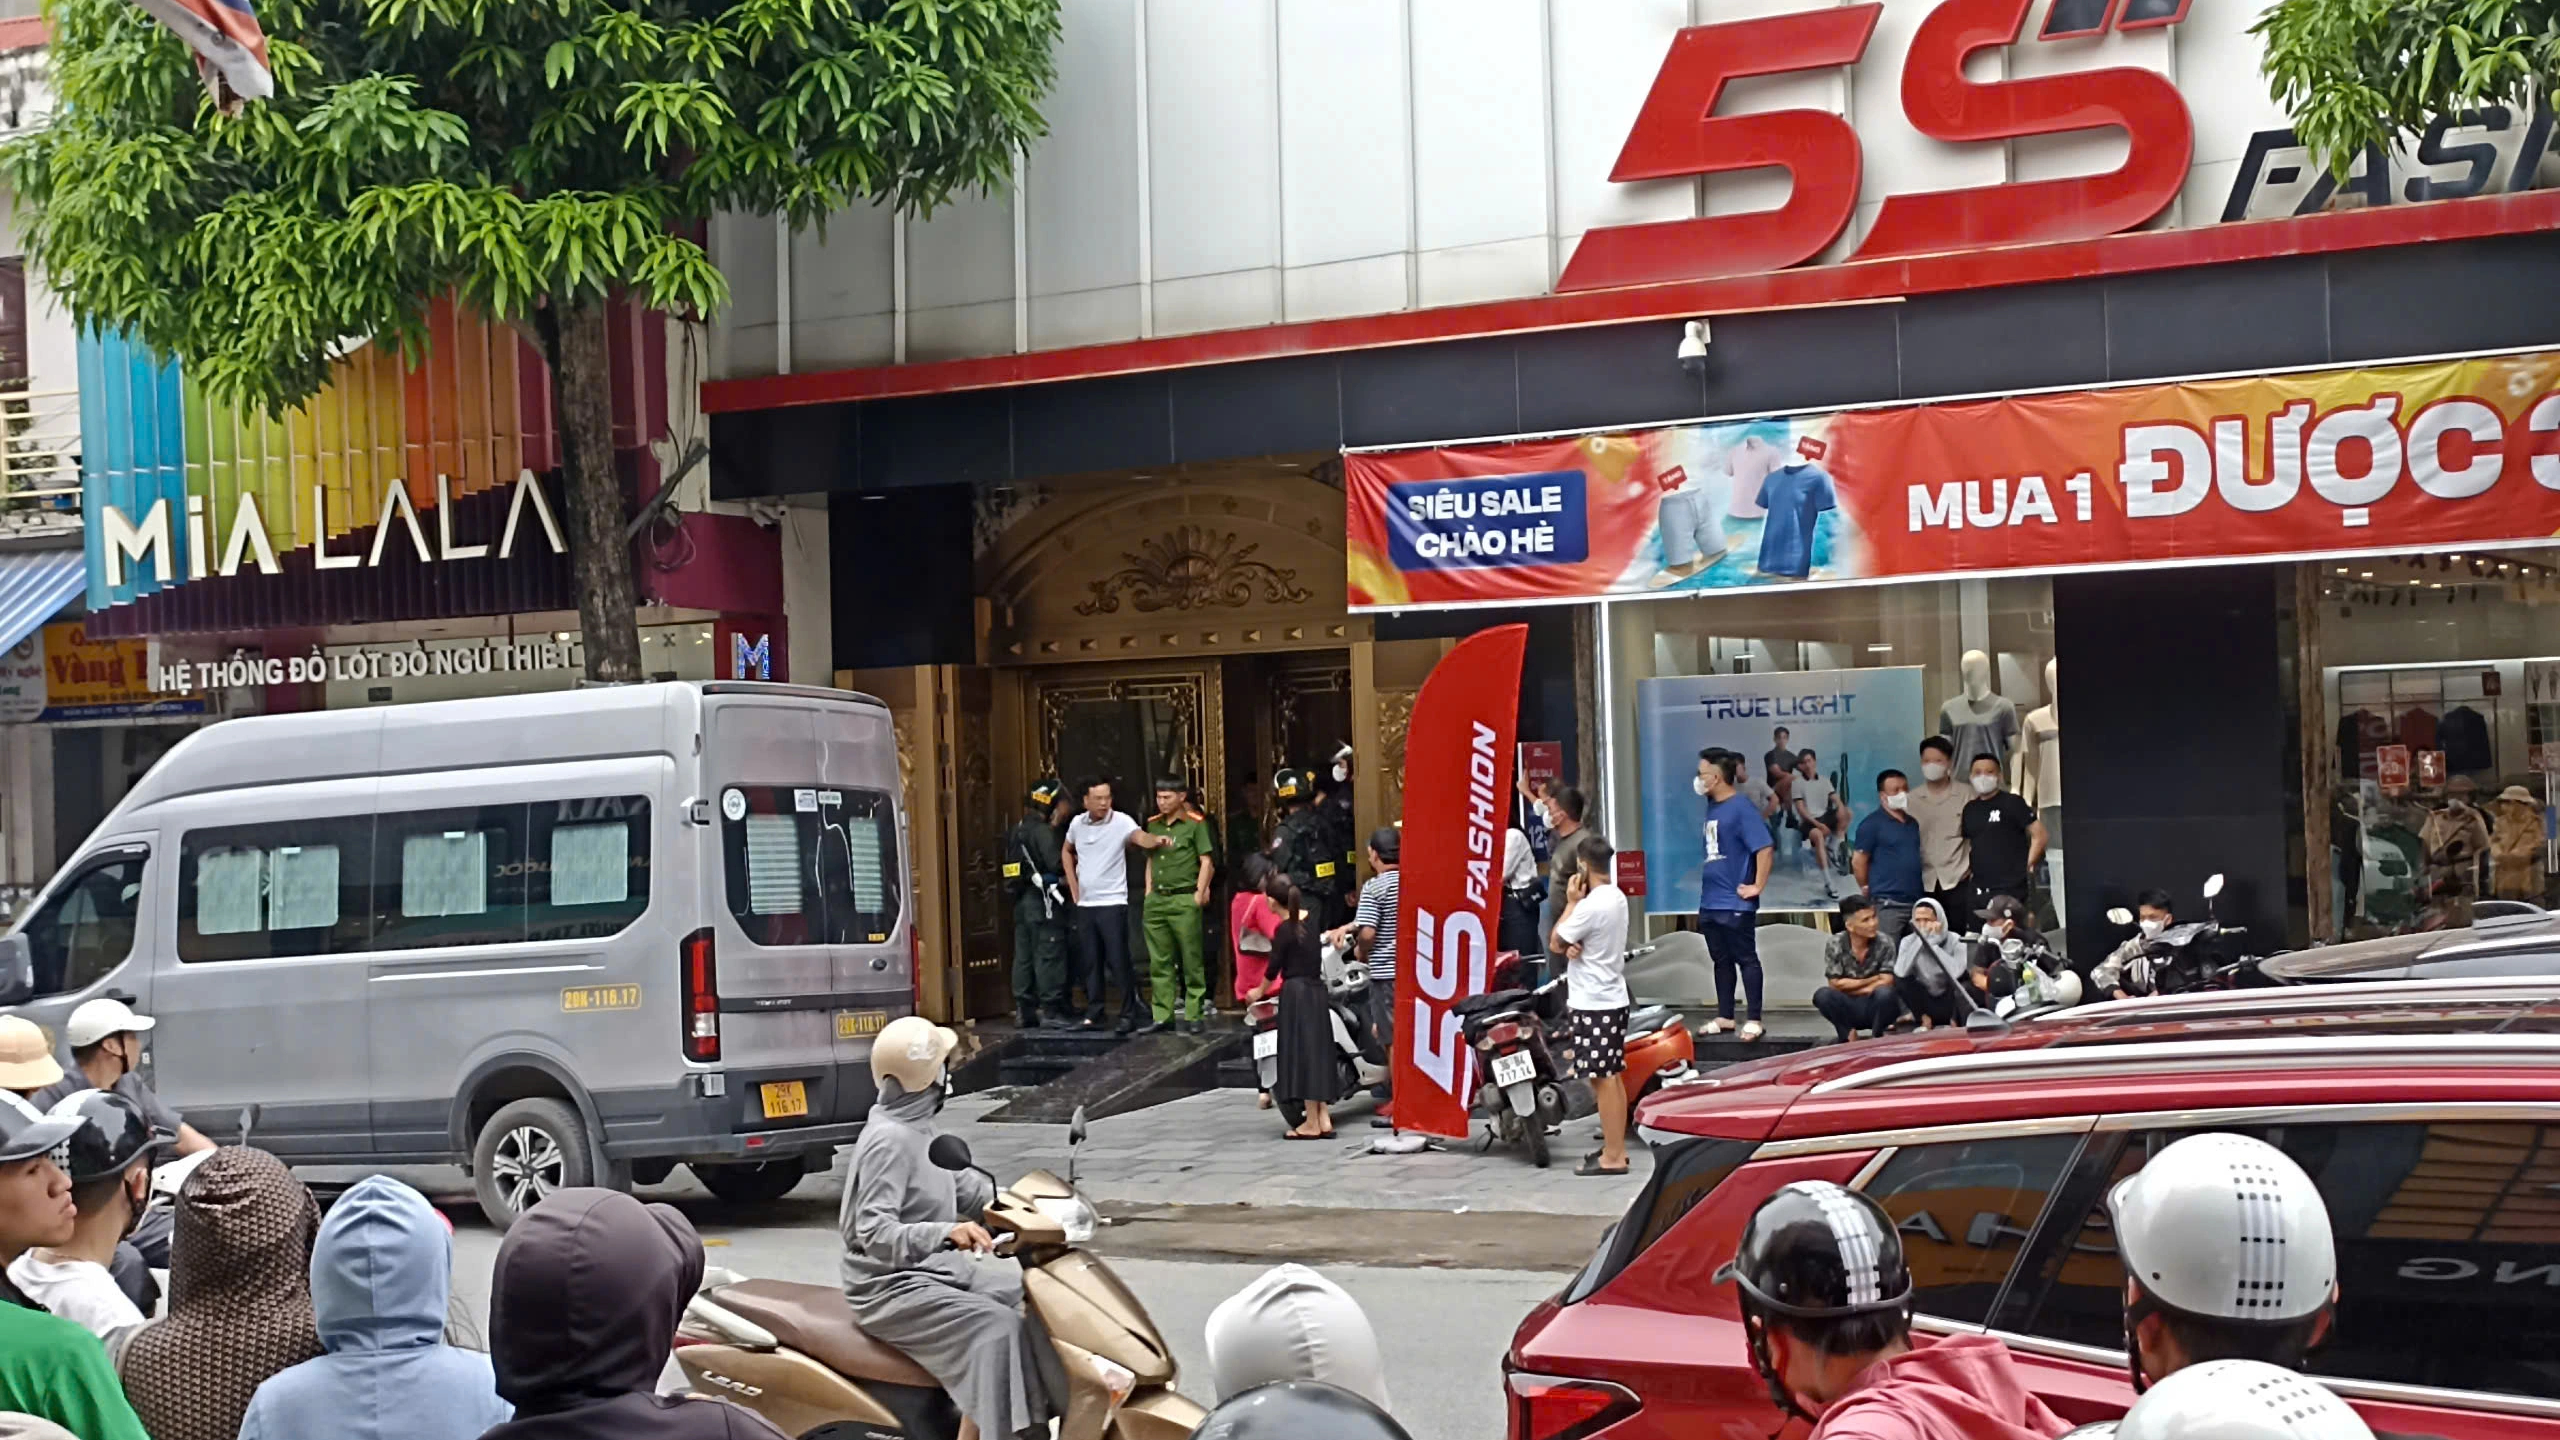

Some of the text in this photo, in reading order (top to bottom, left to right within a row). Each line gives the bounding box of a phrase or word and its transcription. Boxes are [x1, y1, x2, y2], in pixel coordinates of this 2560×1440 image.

[1555, 0, 2195, 295] 5S
[1908, 477, 2058, 532] MUA
[2066, 473, 2092, 521] 1
[2120, 397, 2503, 528] ĐƯỢC
[314, 468, 568, 570] LALA
[1408, 486, 1562, 522] SIÊU SALE
[1415, 520, 1554, 558] CHÀO HÈ
[160, 659, 192, 695] HỆ
[197, 648, 284, 688] THỐNG
[289, 644, 326, 683] ĐỒ
[335, 647, 382, 681] LÓT
[391, 639, 428, 677] ĐỒ
[732, 632, 770, 680] M
[1701, 694, 1856, 719] TRUE LIGHT
[1466, 720, 1498, 910] FASHION
